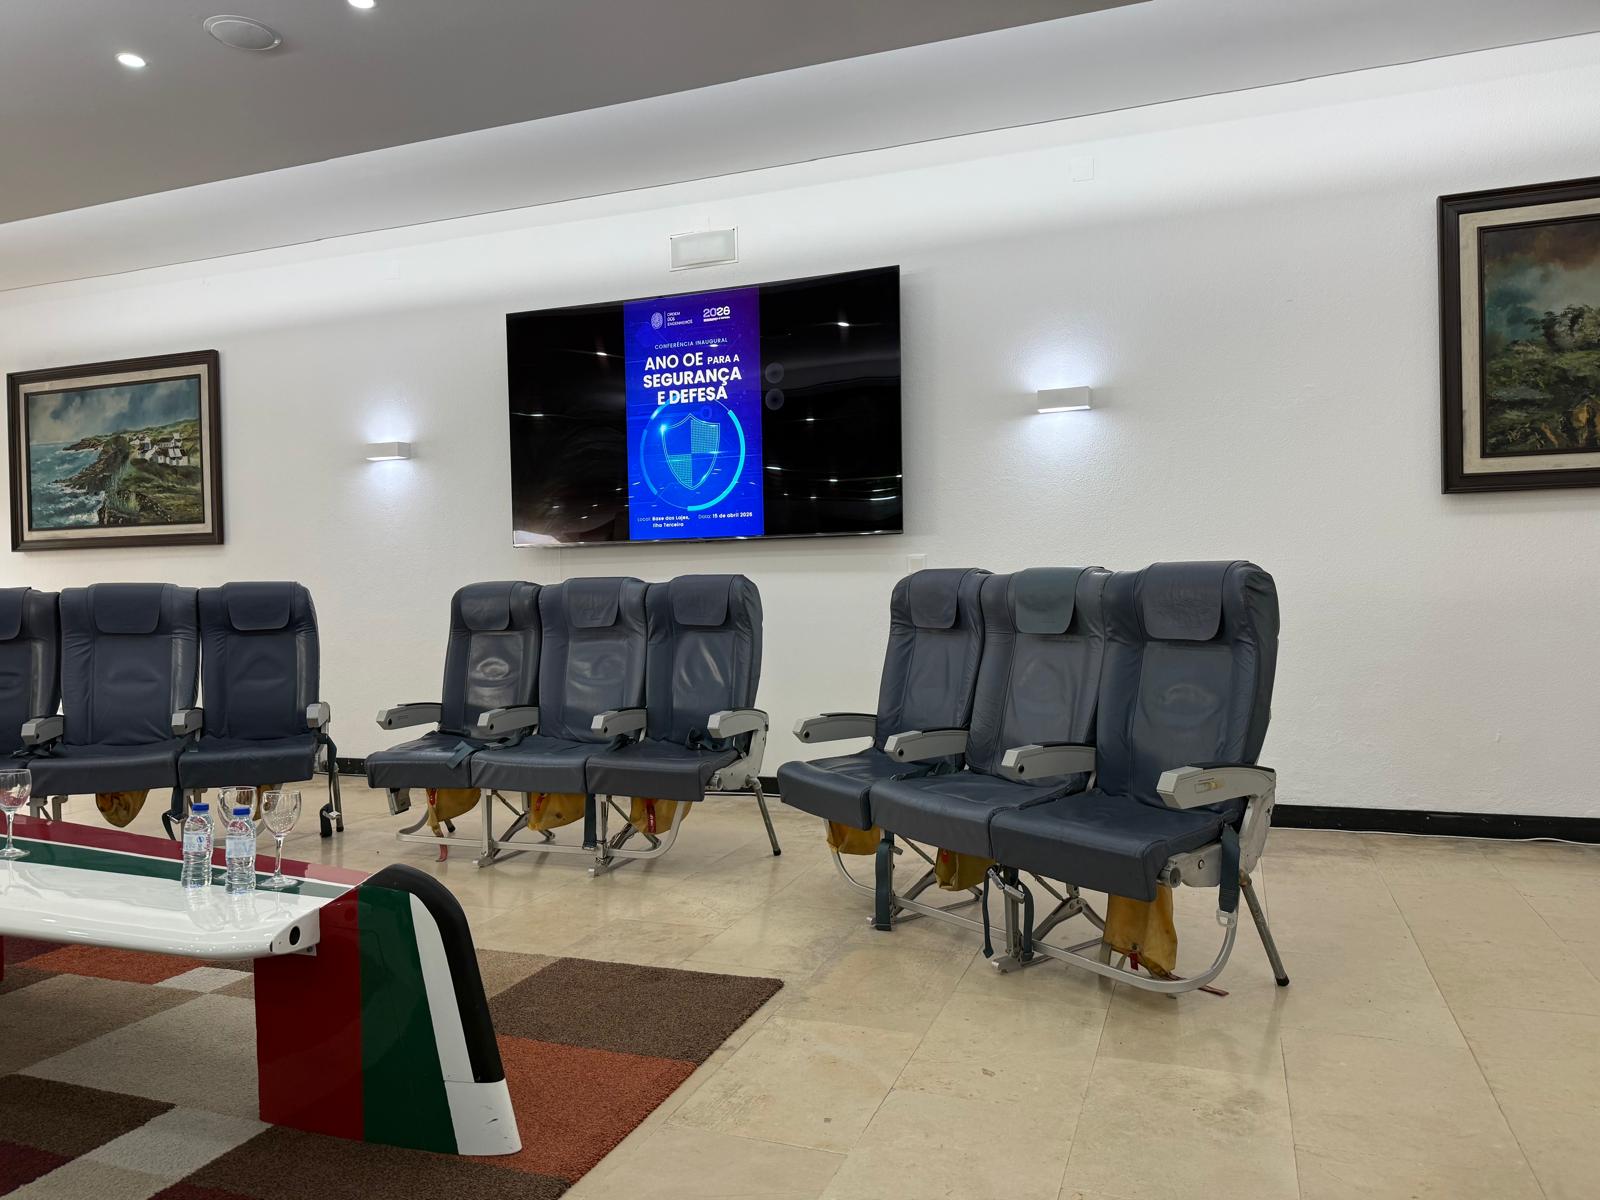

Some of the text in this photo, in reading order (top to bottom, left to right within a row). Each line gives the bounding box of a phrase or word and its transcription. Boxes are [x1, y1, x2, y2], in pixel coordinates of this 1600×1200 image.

[654, 342, 694, 350] CONFERÊNCIA
[644, 352, 740, 371] ANO OE PARA A
[643, 366, 742, 388] SEGURANÇA
[657, 386, 728, 406] E DEFESA
